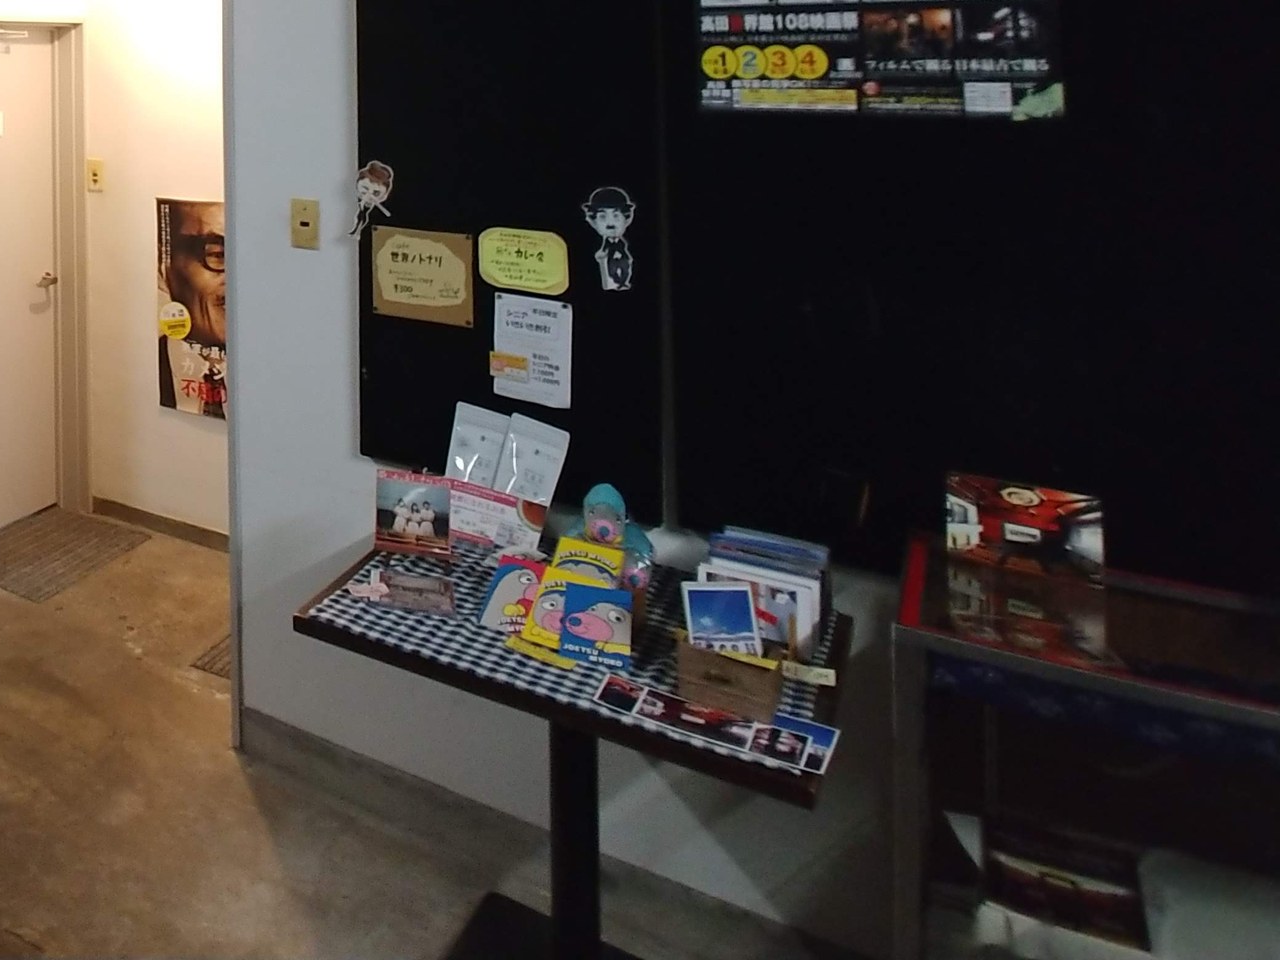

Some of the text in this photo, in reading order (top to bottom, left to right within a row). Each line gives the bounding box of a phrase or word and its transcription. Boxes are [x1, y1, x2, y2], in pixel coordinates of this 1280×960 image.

[742, 51, 756, 67] 2
[771, 50, 786, 67] 3
[801, 50, 816, 67] 4
[563, 643, 599, 655] JOETSU
[588, 655, 624, 667] MYOKO
